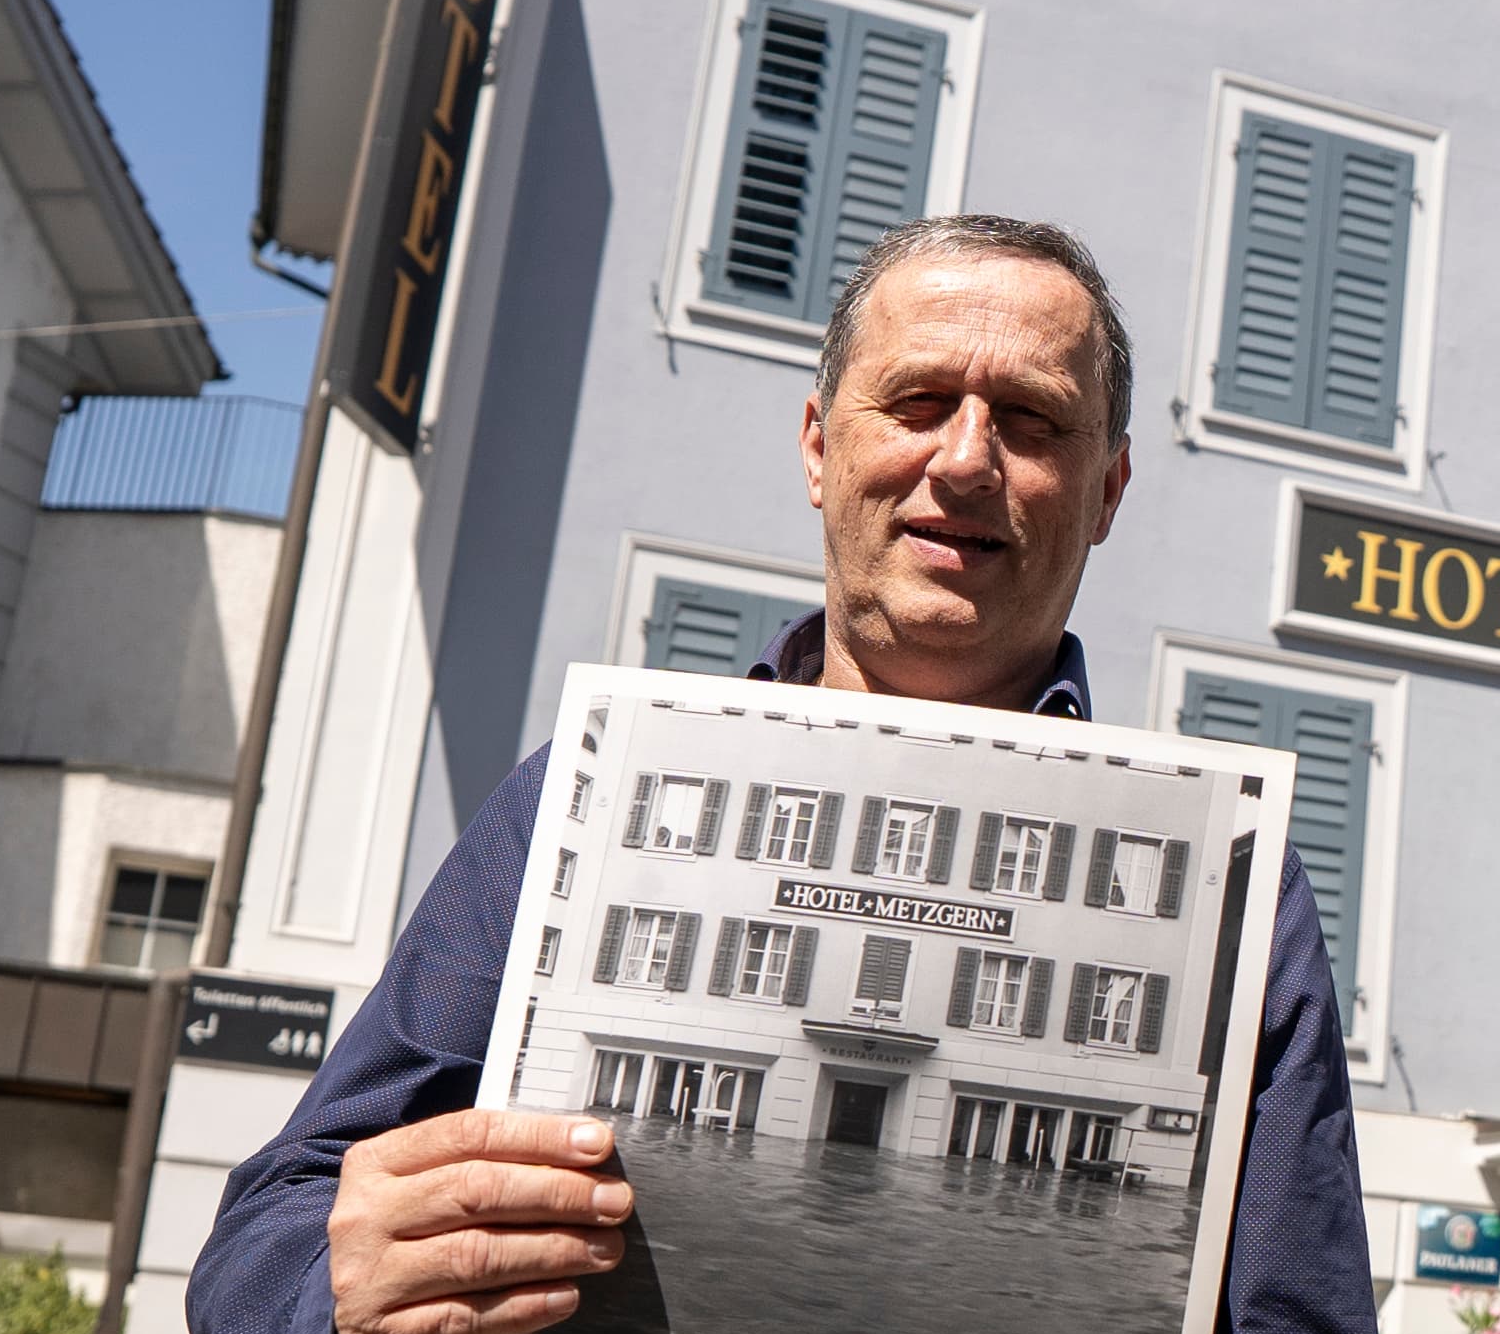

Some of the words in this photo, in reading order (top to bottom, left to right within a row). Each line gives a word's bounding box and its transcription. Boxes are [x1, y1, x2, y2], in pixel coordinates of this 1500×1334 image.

[790, 884, 865, 914] HOTEL
[874, 895, 998, 931] METZGERN
[193, 986, 257, 1010] Toiletten
[1420, 1250, 1498, 1273] PAULANER
